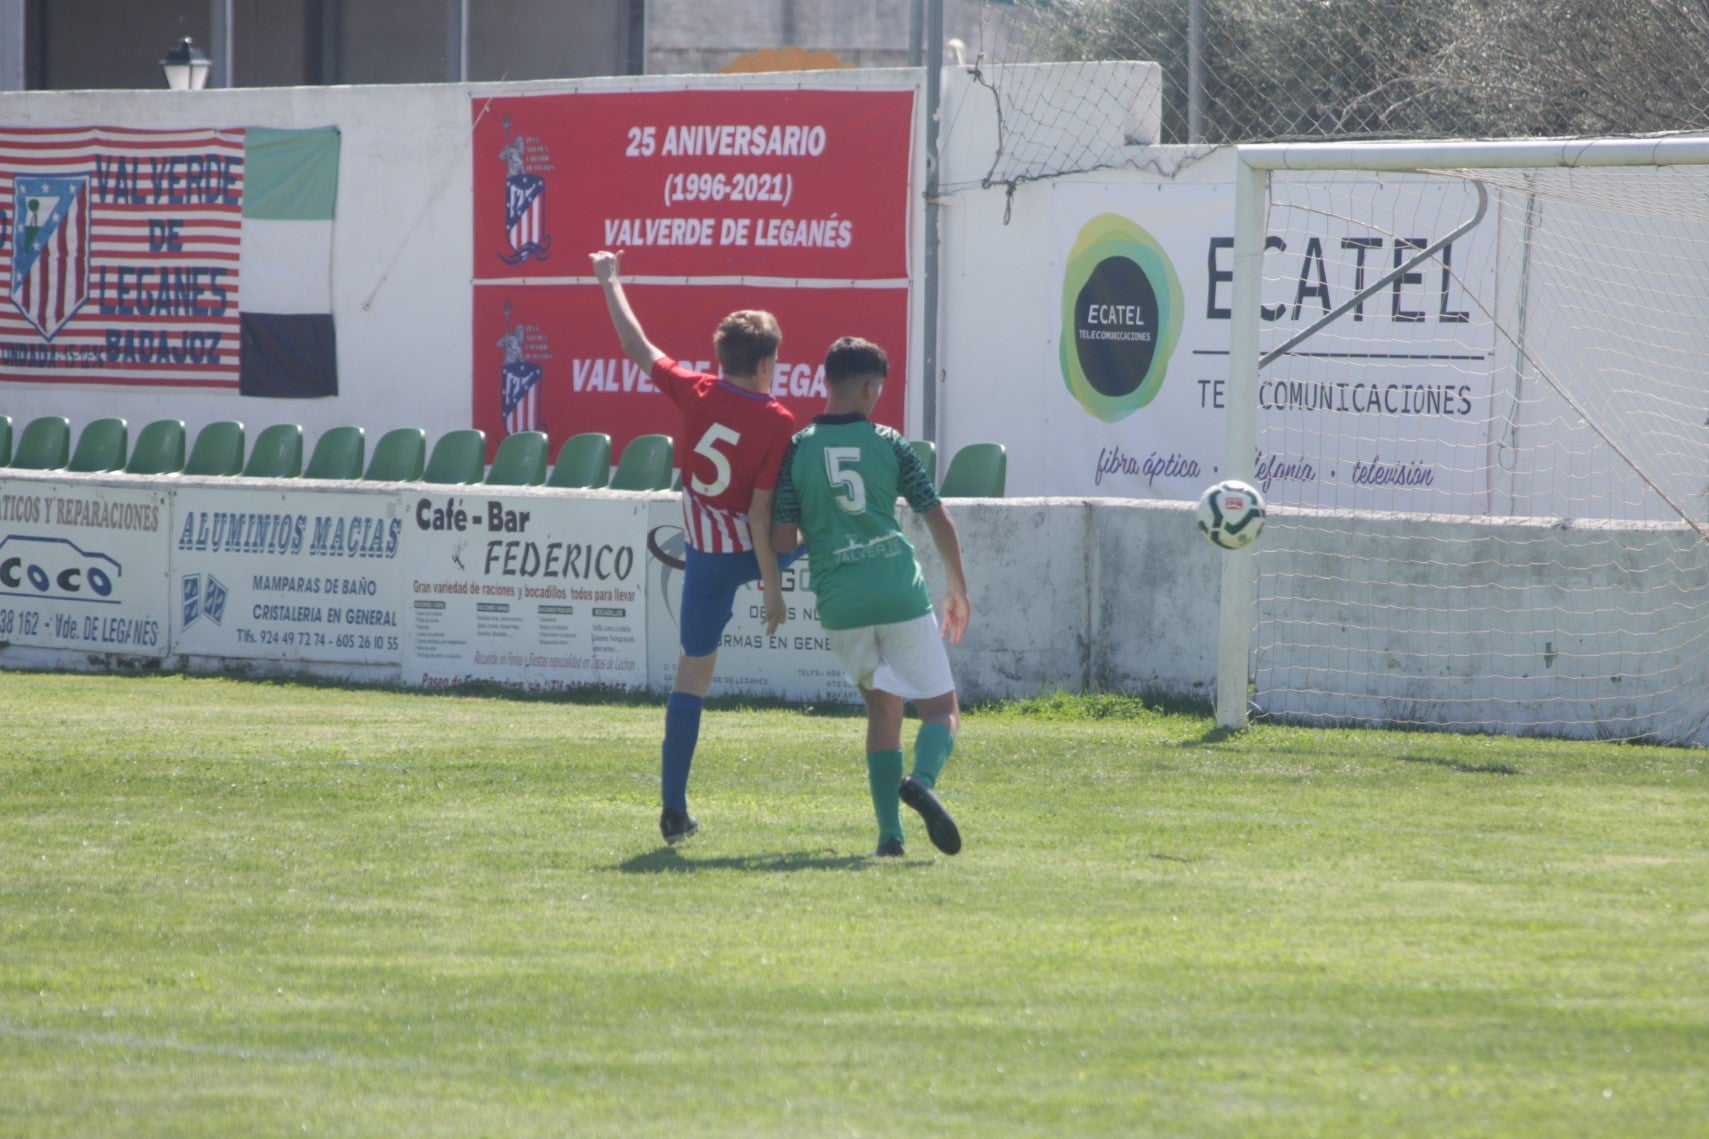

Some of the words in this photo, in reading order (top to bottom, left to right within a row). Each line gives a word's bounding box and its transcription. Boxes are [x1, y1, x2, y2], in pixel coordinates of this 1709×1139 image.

[626, 127, 656, 156] 25
[661, 125, 826, 156] ANIVERSARIO
[95, 153, 243, 205] VALVERDE
[664, 173, 792, 207] (1996-2021)
[148, 219, 183, 252] DE
[605, 219, 713, 246] VALVERDE
[720, 219, 749, 246] DE
[755, 213, 852, 248] LEGANÉS
[1088, 304, 1144, 325] ECATEL
[105, 329, 222, 364] BADAJOZ
[1079, 330, 1151, 341] TELECOMUNICACIONES
[1198, 379, 1472, 415] TECOMUNICACIONES
[691, 423, 740, 497] 5
[1095, 446, 1140, 485] fibra
[1142, 451, 1201, 486] óptica
[1352, 455, 1433, 486] televisión
[824, 447, 866, 514] 5
[0, 495, 41, 523] TICOS
[44, 498, 53, 524] Y
[57, 497, 159, 532] REPARACIONES
[178, 511, 306, 555] ALUMINIOS
[309, 516, 402, 559] MACIAS
[484, 540, 633, 580] FEDERICO
[252, 575, 320, 594] MAMPARAS
[324, 578, 339, 595] DE
[342, 577, 376, 596] BAÑO
[413, 580, 430, 593] Gran
[433, 581, 467, 594] variedad
[469, 581, 480, 594] de
[482, 582, 515, 596] raciones
[524, 584, 566, 599] bocadillos
[570, 587, 592, 600] todos
[595, 590, 612, 602] para
[614, 588, 635, 602] llevar
[0, 609, 14, 634] 38
[18, 611, 39, 636] 162
[84, 616, 99, 641] DE
[253, 604, 322, 623] CRISTALERIA
[327, 608, 341, 624] EN
[346, 608, 397, 627] GENERAL
[236, 629, 257, 643] Tlfs.
[260, 630, 279, 645] 924
[282, 631, 295, 645] 49
[298, 632, 311, 646] 72
[314, 633, 325, 647] 74
[336, 634, 355, 648] 605
[358, 635, 371, 649] 26
[387, 636, 398, 650] 55
[769, 637, 787, 649] EN
